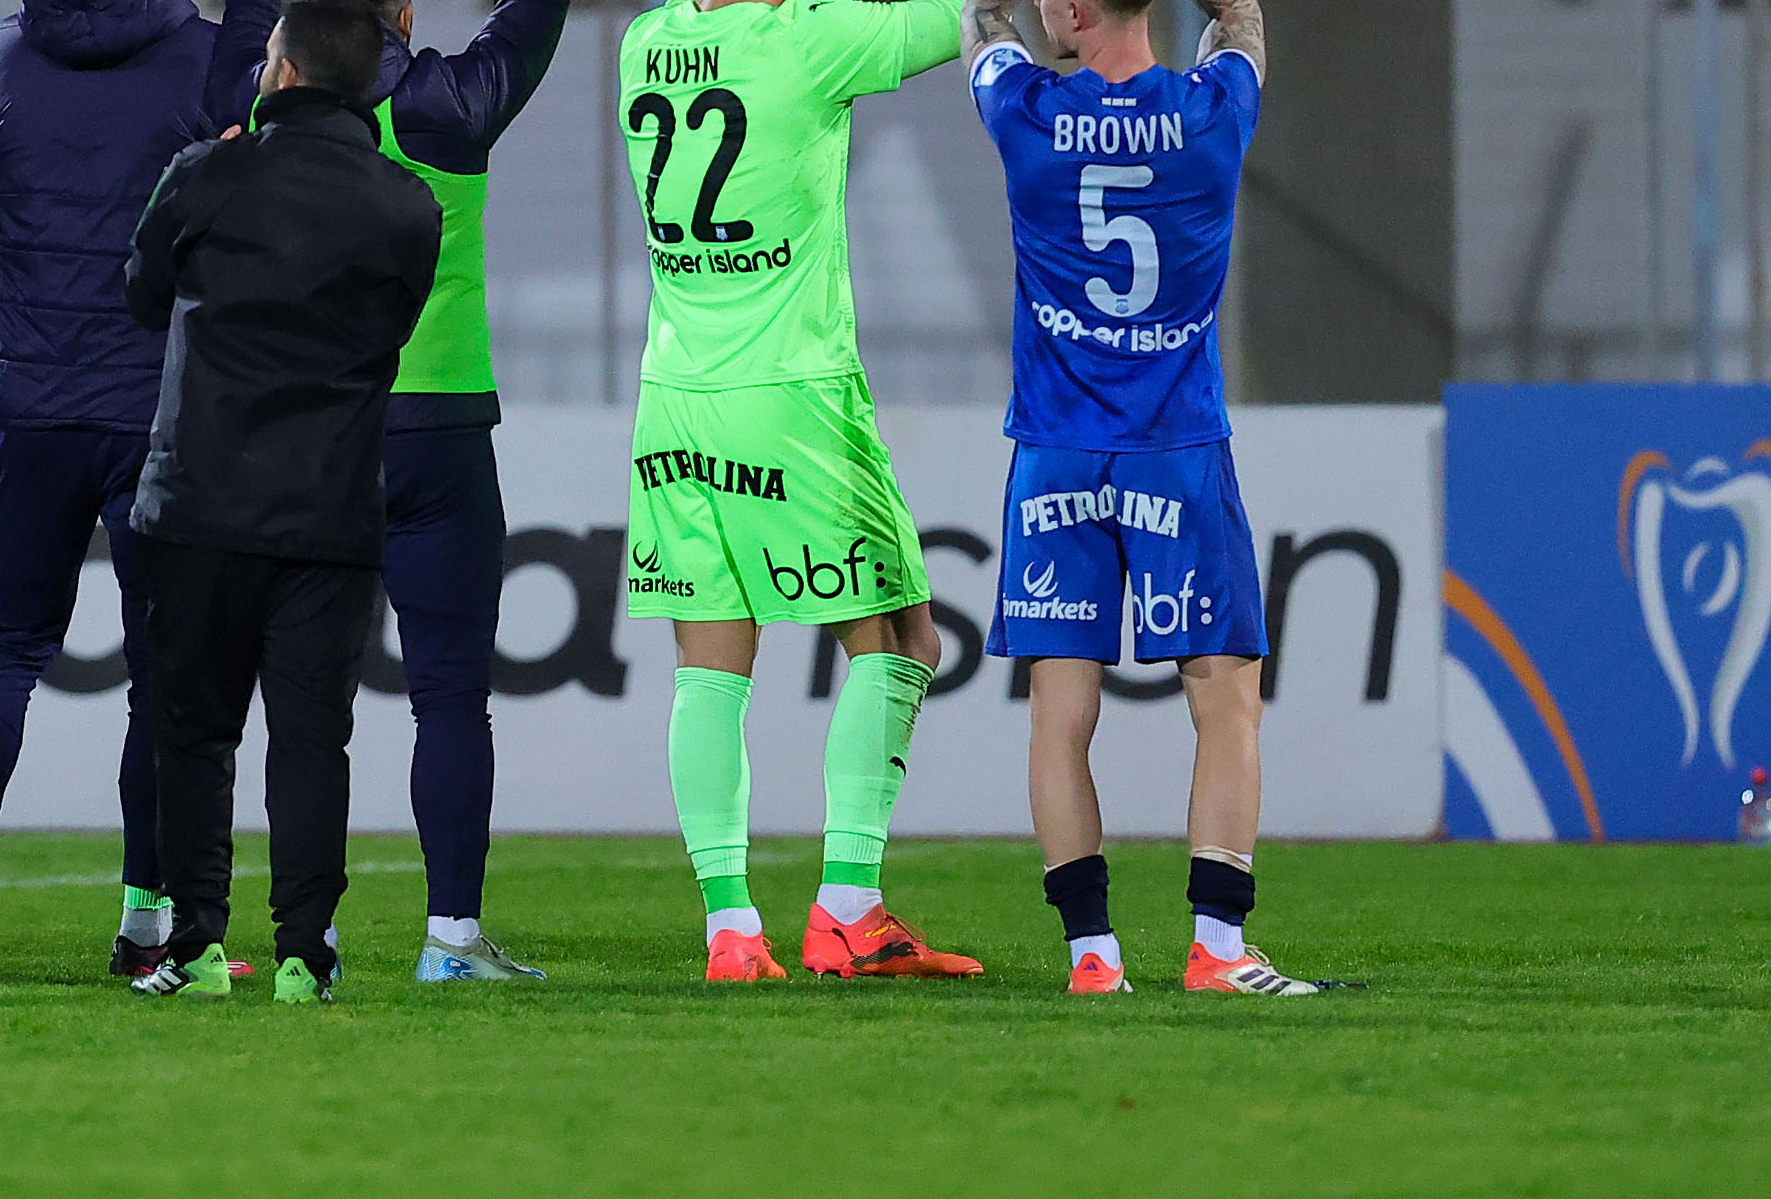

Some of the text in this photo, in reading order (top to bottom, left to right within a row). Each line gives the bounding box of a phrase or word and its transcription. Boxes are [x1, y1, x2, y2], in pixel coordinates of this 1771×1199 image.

[1053, 112, 1184, 154] BROWN
[628, 88, 754, 244] 22
[648, 238, 792, 277] opper island
[1078, 164, 1160, 318] 5
[762, 537, 886, 601] bbf:
